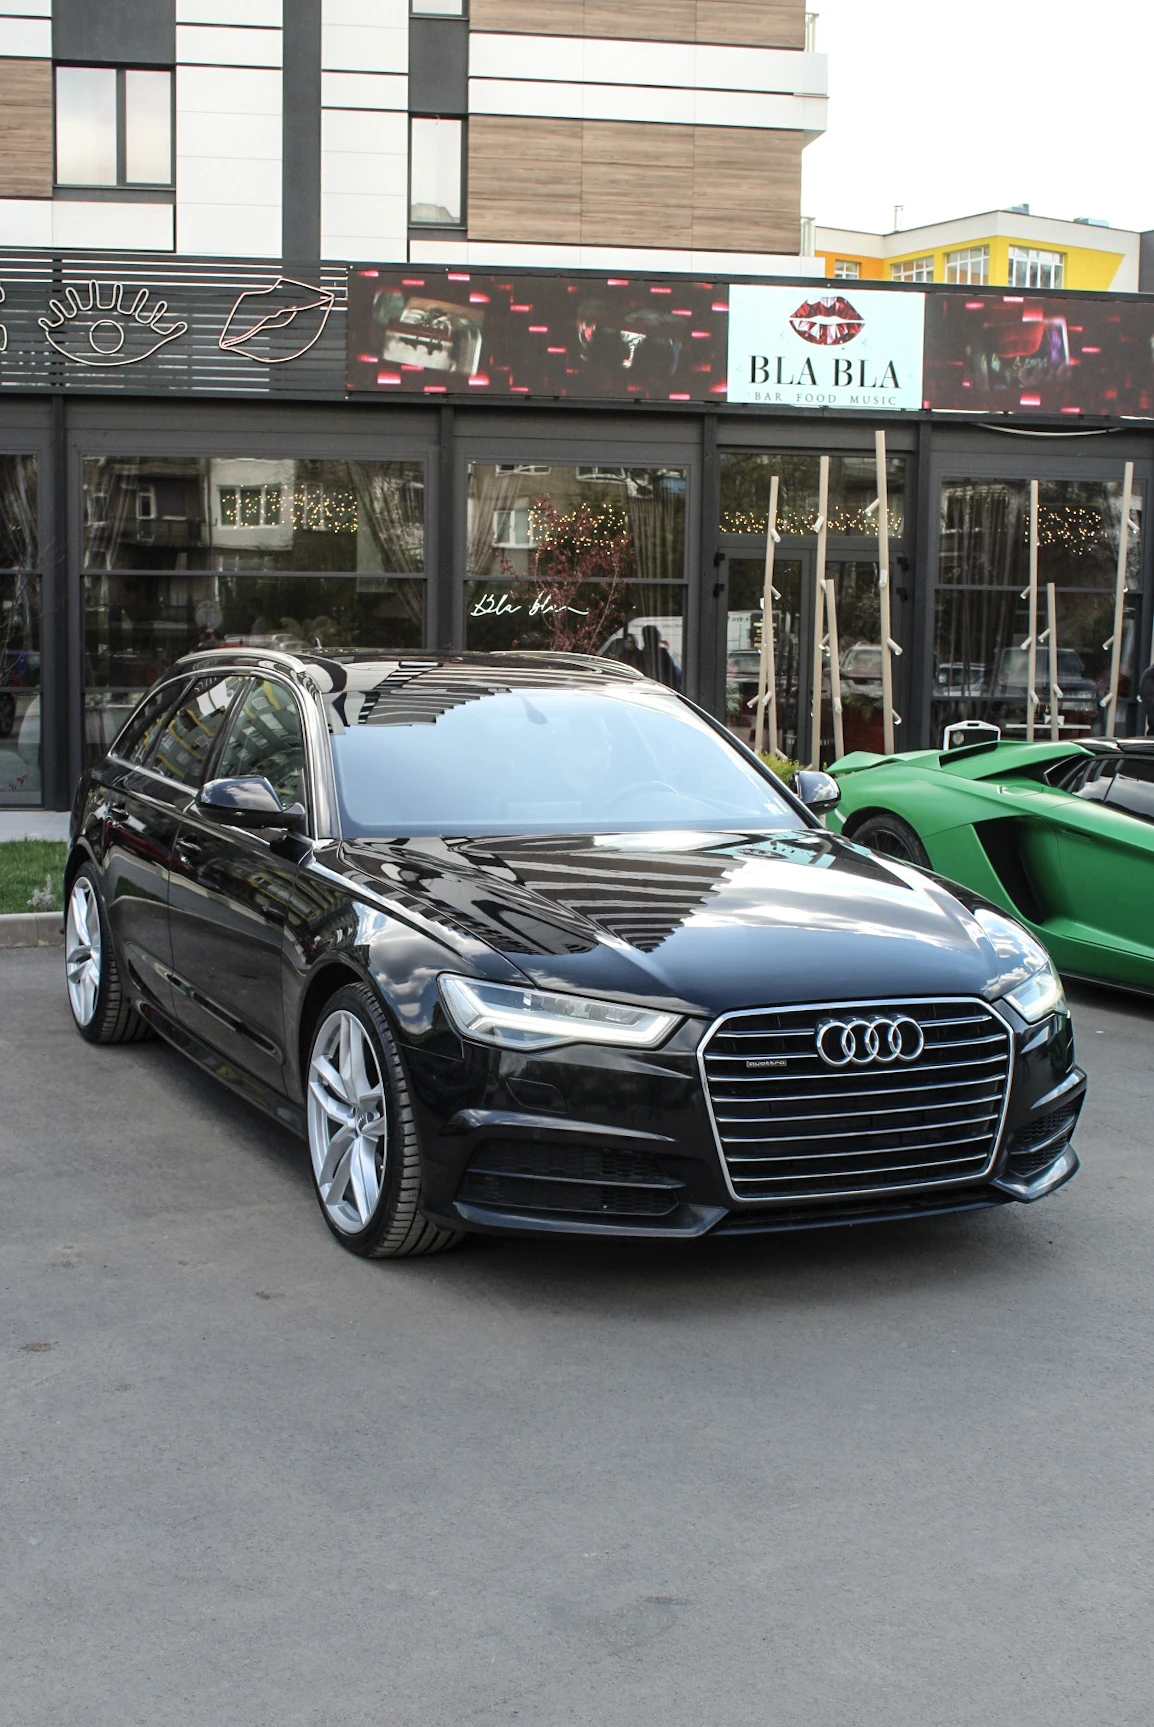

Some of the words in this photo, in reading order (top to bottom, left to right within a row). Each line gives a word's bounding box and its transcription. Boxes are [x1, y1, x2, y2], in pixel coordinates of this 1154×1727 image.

[749, 355, 820, 386] BLA
[832, 358, 902, 389] BLA
[754, 392, 783, 402] BAR
[796, 393, 837, 404] FOOD
[850, 395, 897, 406] MUSIC
[470, 594, 522, 617] Bla
[747, 1060, 786, 1068] quattro
